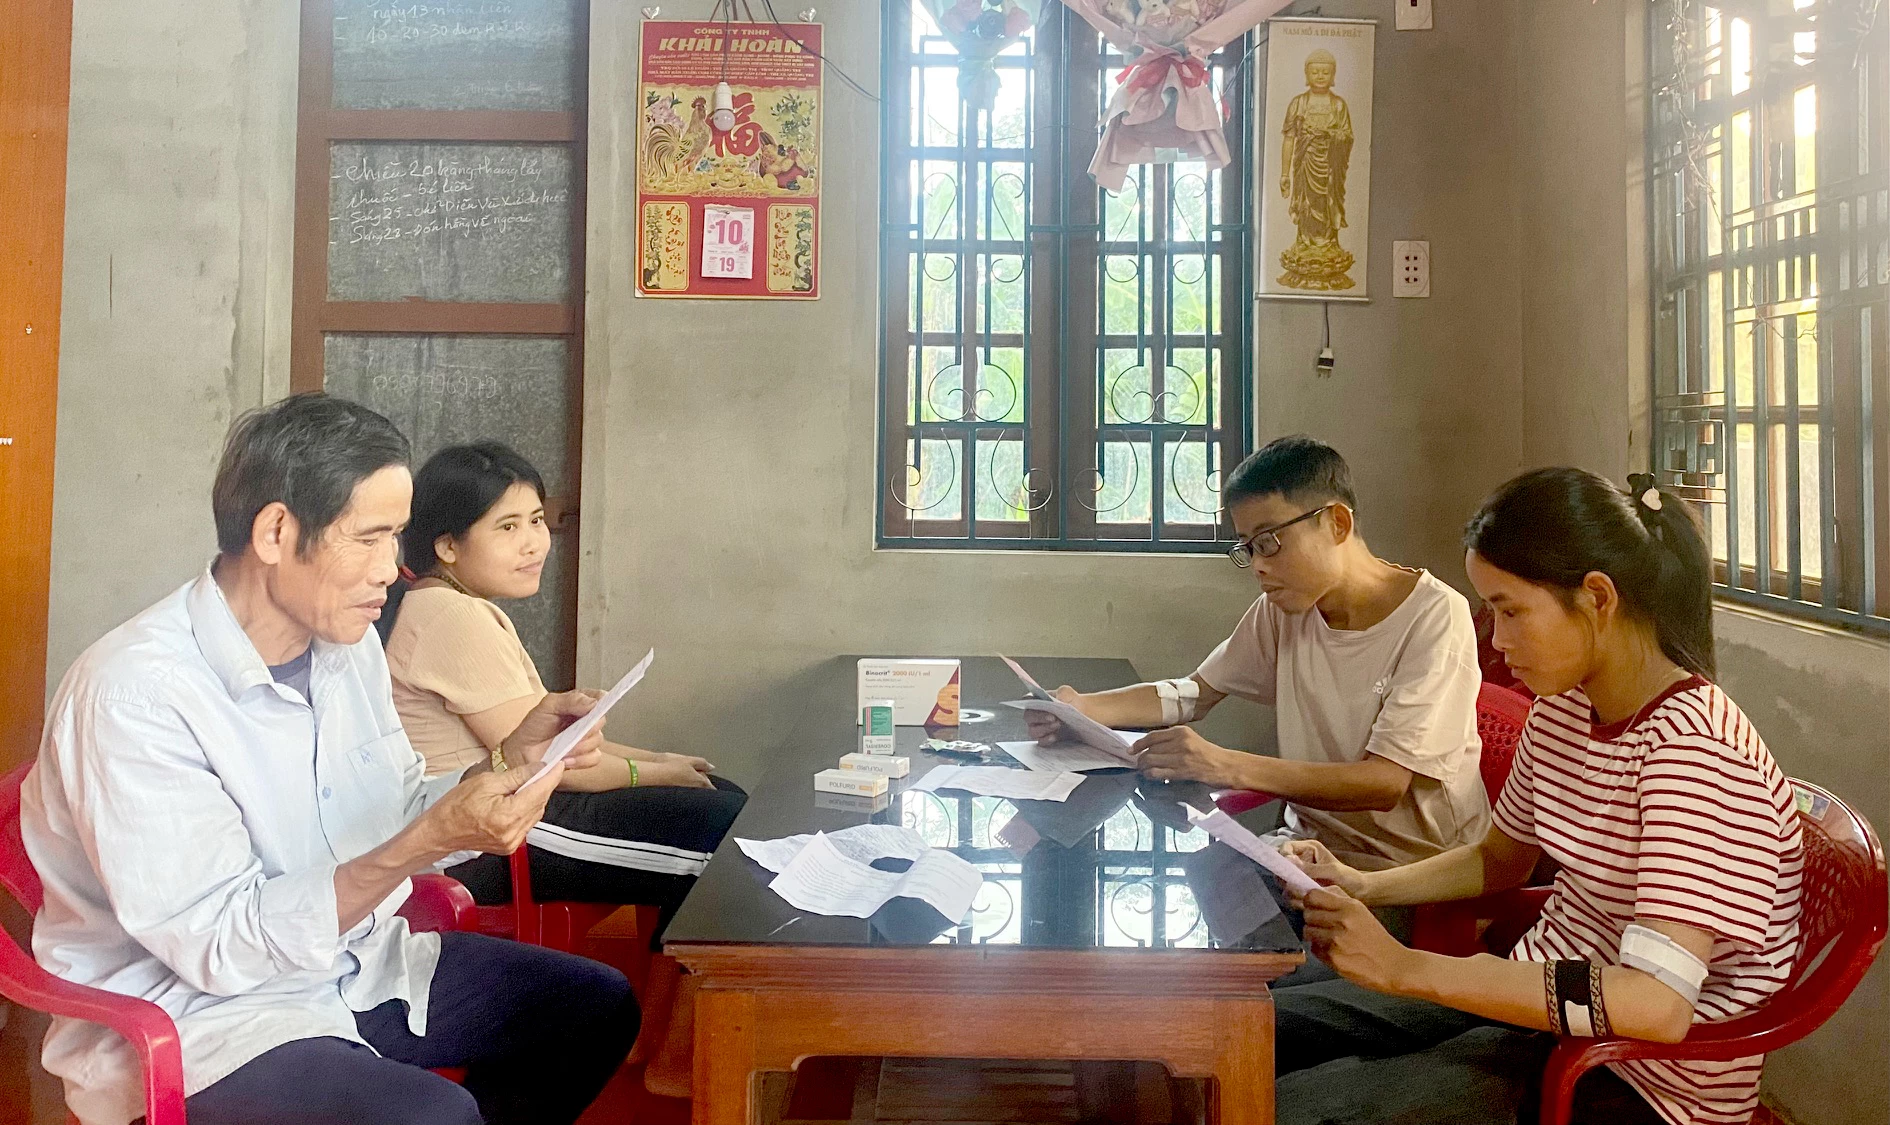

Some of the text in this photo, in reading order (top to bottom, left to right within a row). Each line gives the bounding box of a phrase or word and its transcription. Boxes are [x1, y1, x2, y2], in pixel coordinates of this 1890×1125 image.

[659, 35, 804, 54] KHẢI HOÀN
[409, 160, 433, 178] 20
[383, 207, 402, 220] 25
[715, 219, 743, 245] 10
[720, 256, 735, 272] 19
